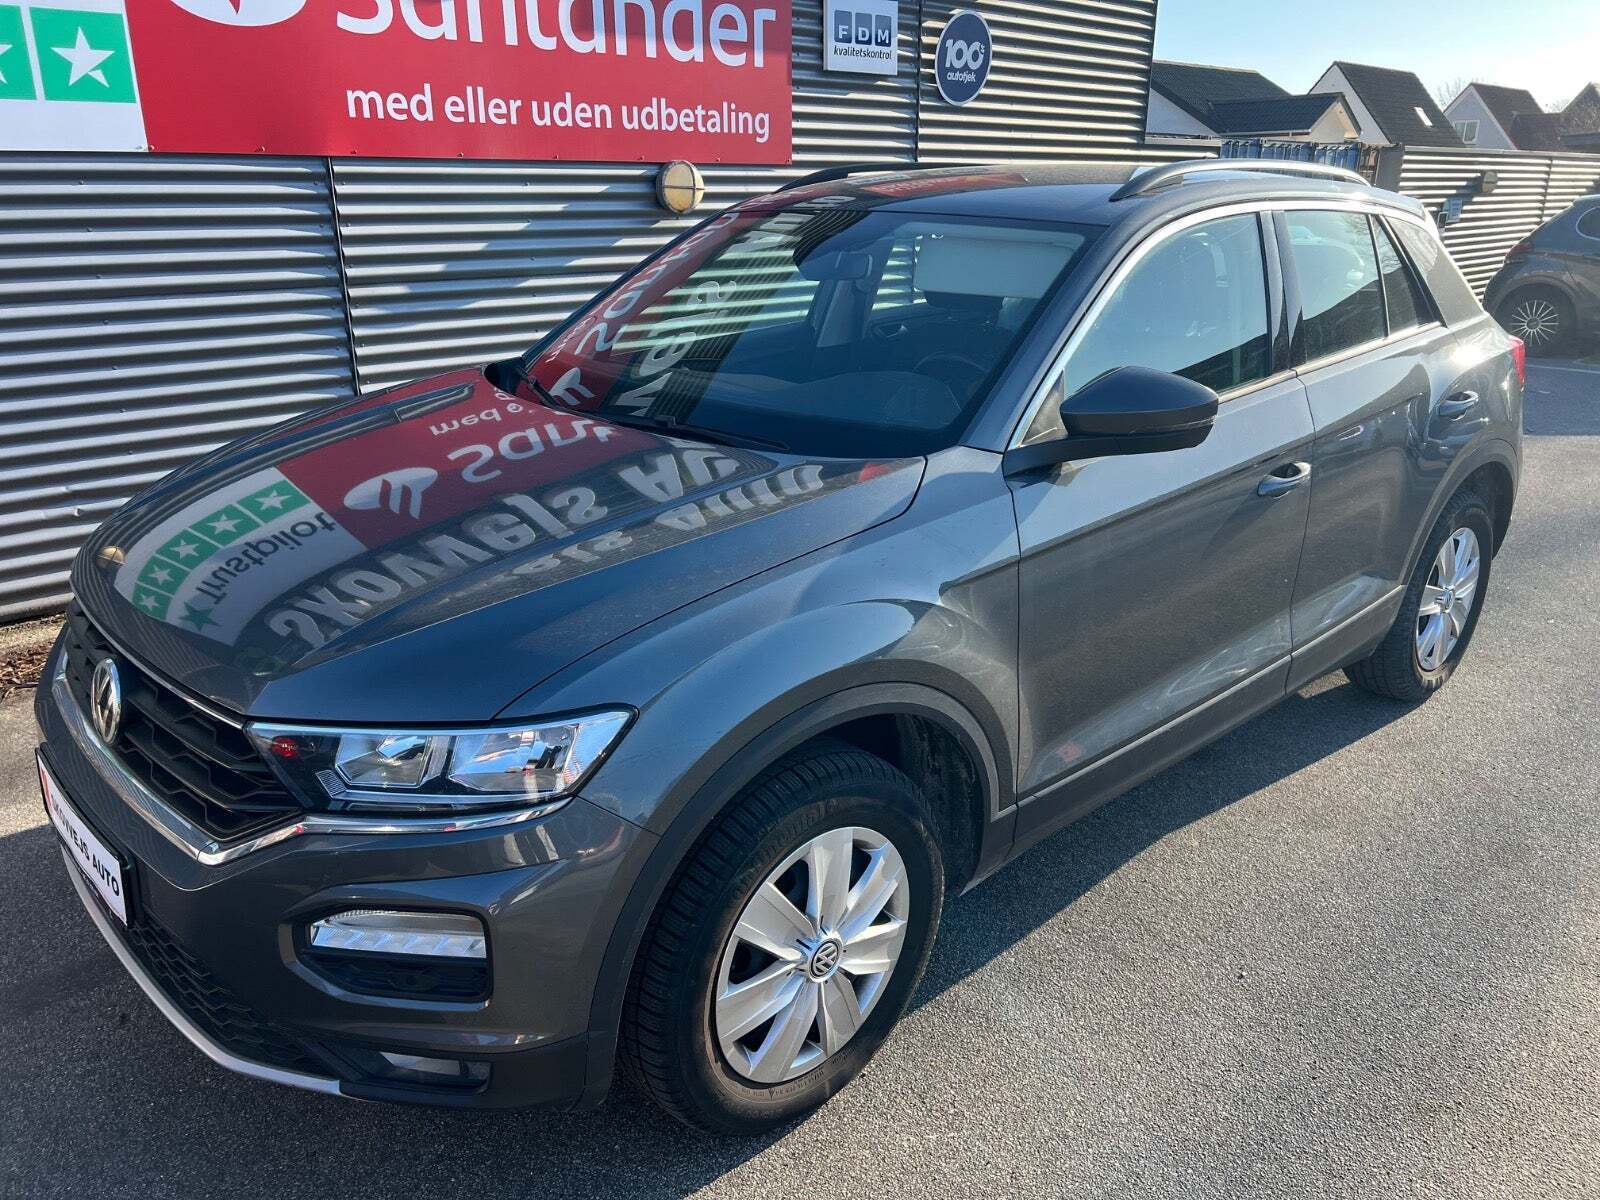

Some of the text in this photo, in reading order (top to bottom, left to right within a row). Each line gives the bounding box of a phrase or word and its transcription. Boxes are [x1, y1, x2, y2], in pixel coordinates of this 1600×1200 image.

[838, 25, 890, 44] FDM
[833, 45, 892, 60] kvalitetskontrol
[346, 84, 770, 143] med eller uden udbetaling
[92, 853, 120, 897] AUTO
